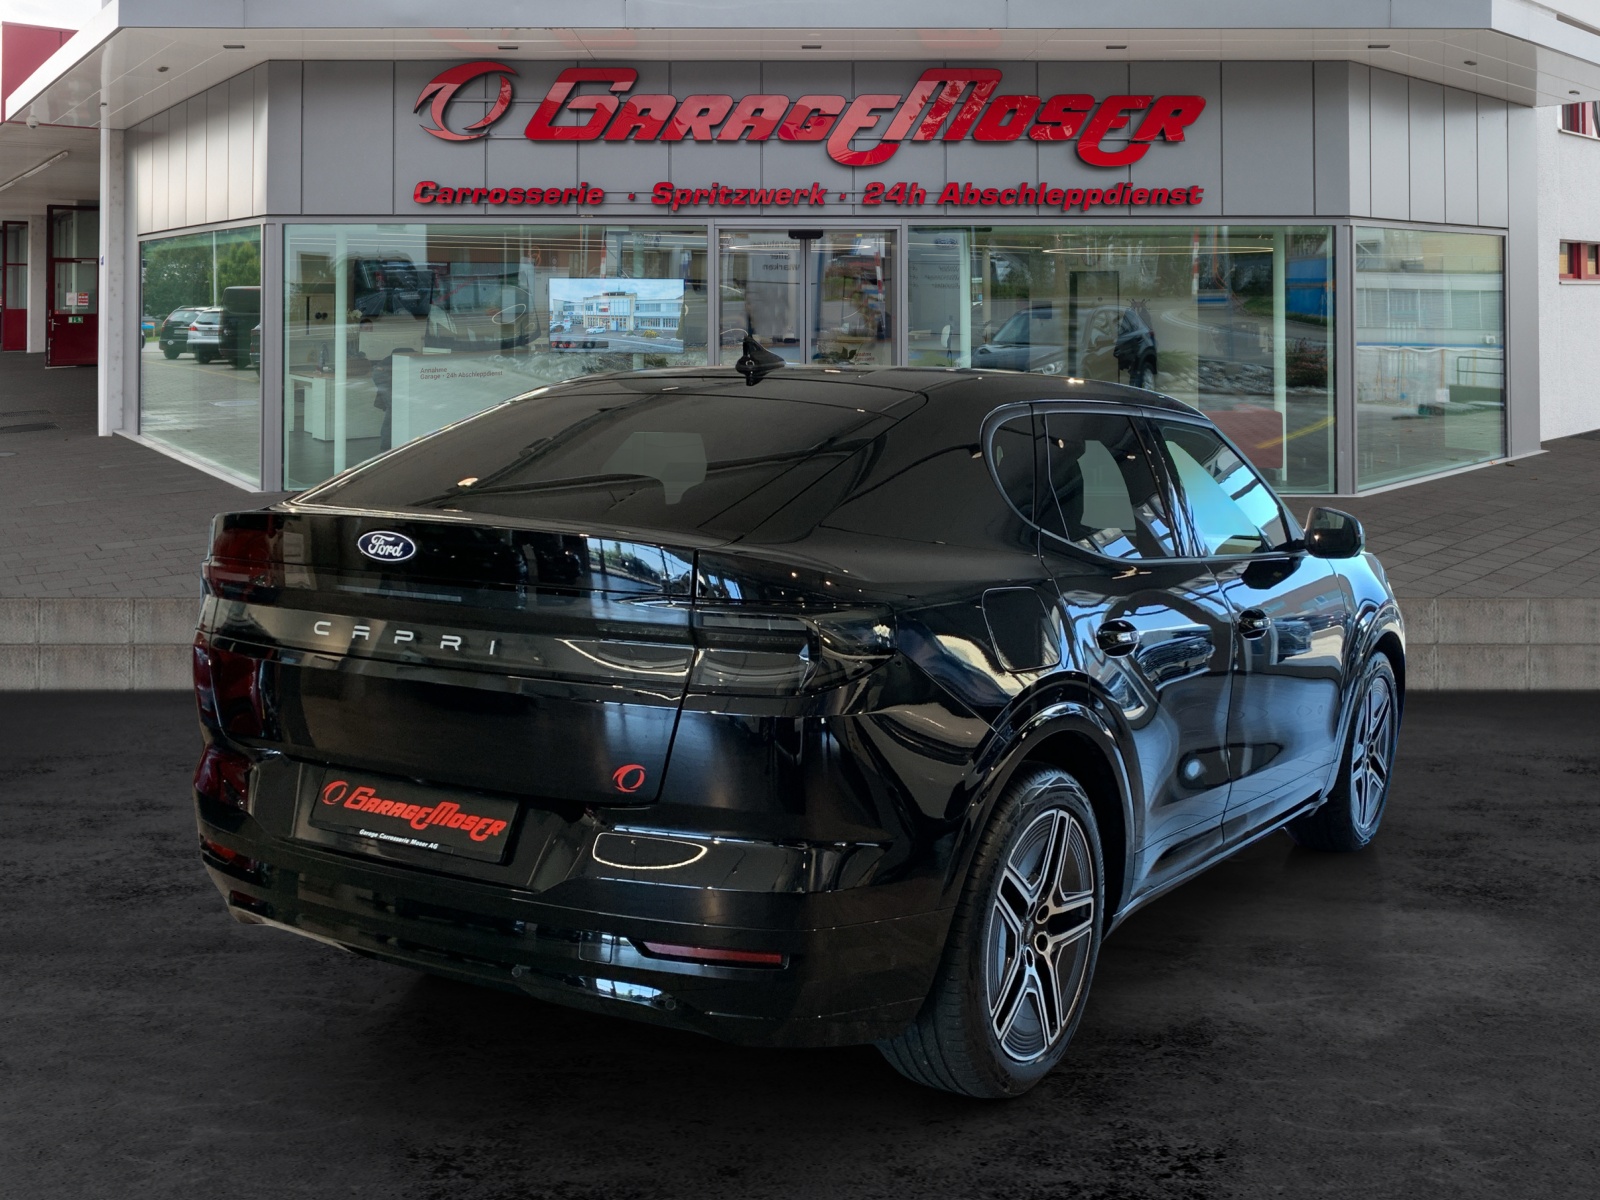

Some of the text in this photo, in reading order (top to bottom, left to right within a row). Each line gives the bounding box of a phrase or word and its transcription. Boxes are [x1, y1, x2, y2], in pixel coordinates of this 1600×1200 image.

[413, 180, 1204, 212] Carrosserie Spritzwerk 24h Abschleppdienst
[458, 370, 503, 379] Abschleppdienst
[368, 534, 404, 557] Ford
[313, 620, 496, 656] CAPRI
[359, 828, 439, 850] Garage Carrosserie Moser AG
